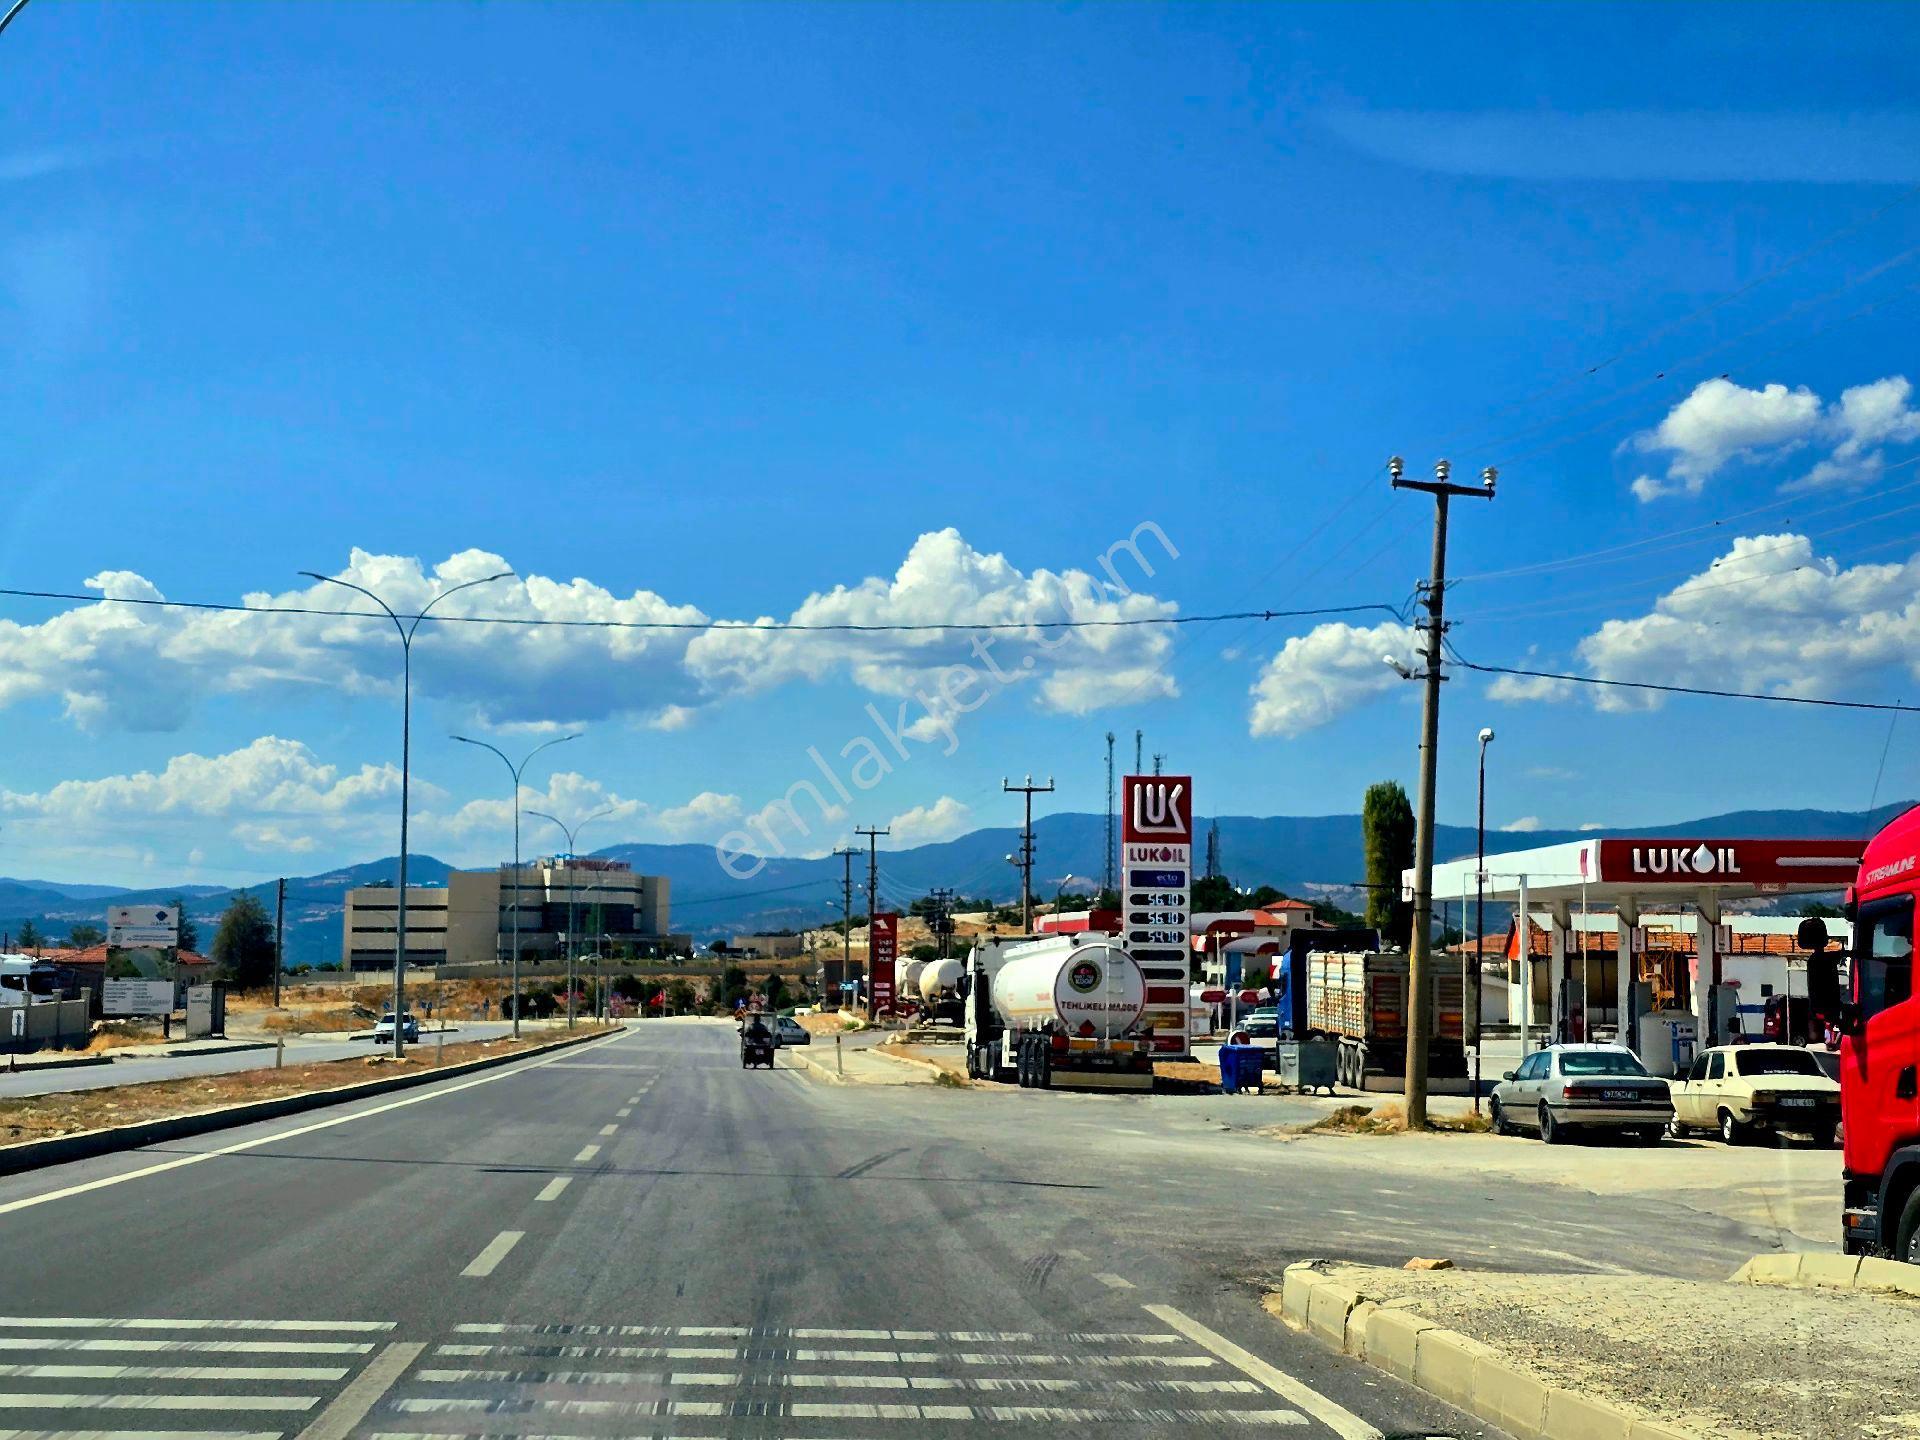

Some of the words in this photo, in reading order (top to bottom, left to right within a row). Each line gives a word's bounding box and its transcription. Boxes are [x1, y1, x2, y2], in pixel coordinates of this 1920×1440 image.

[1129, 847, 1186, 862] LUKOIL
[1633, 843, 1741, 874] LUKOIL
[1865, 855, 1916, 886] STREAMLINE
